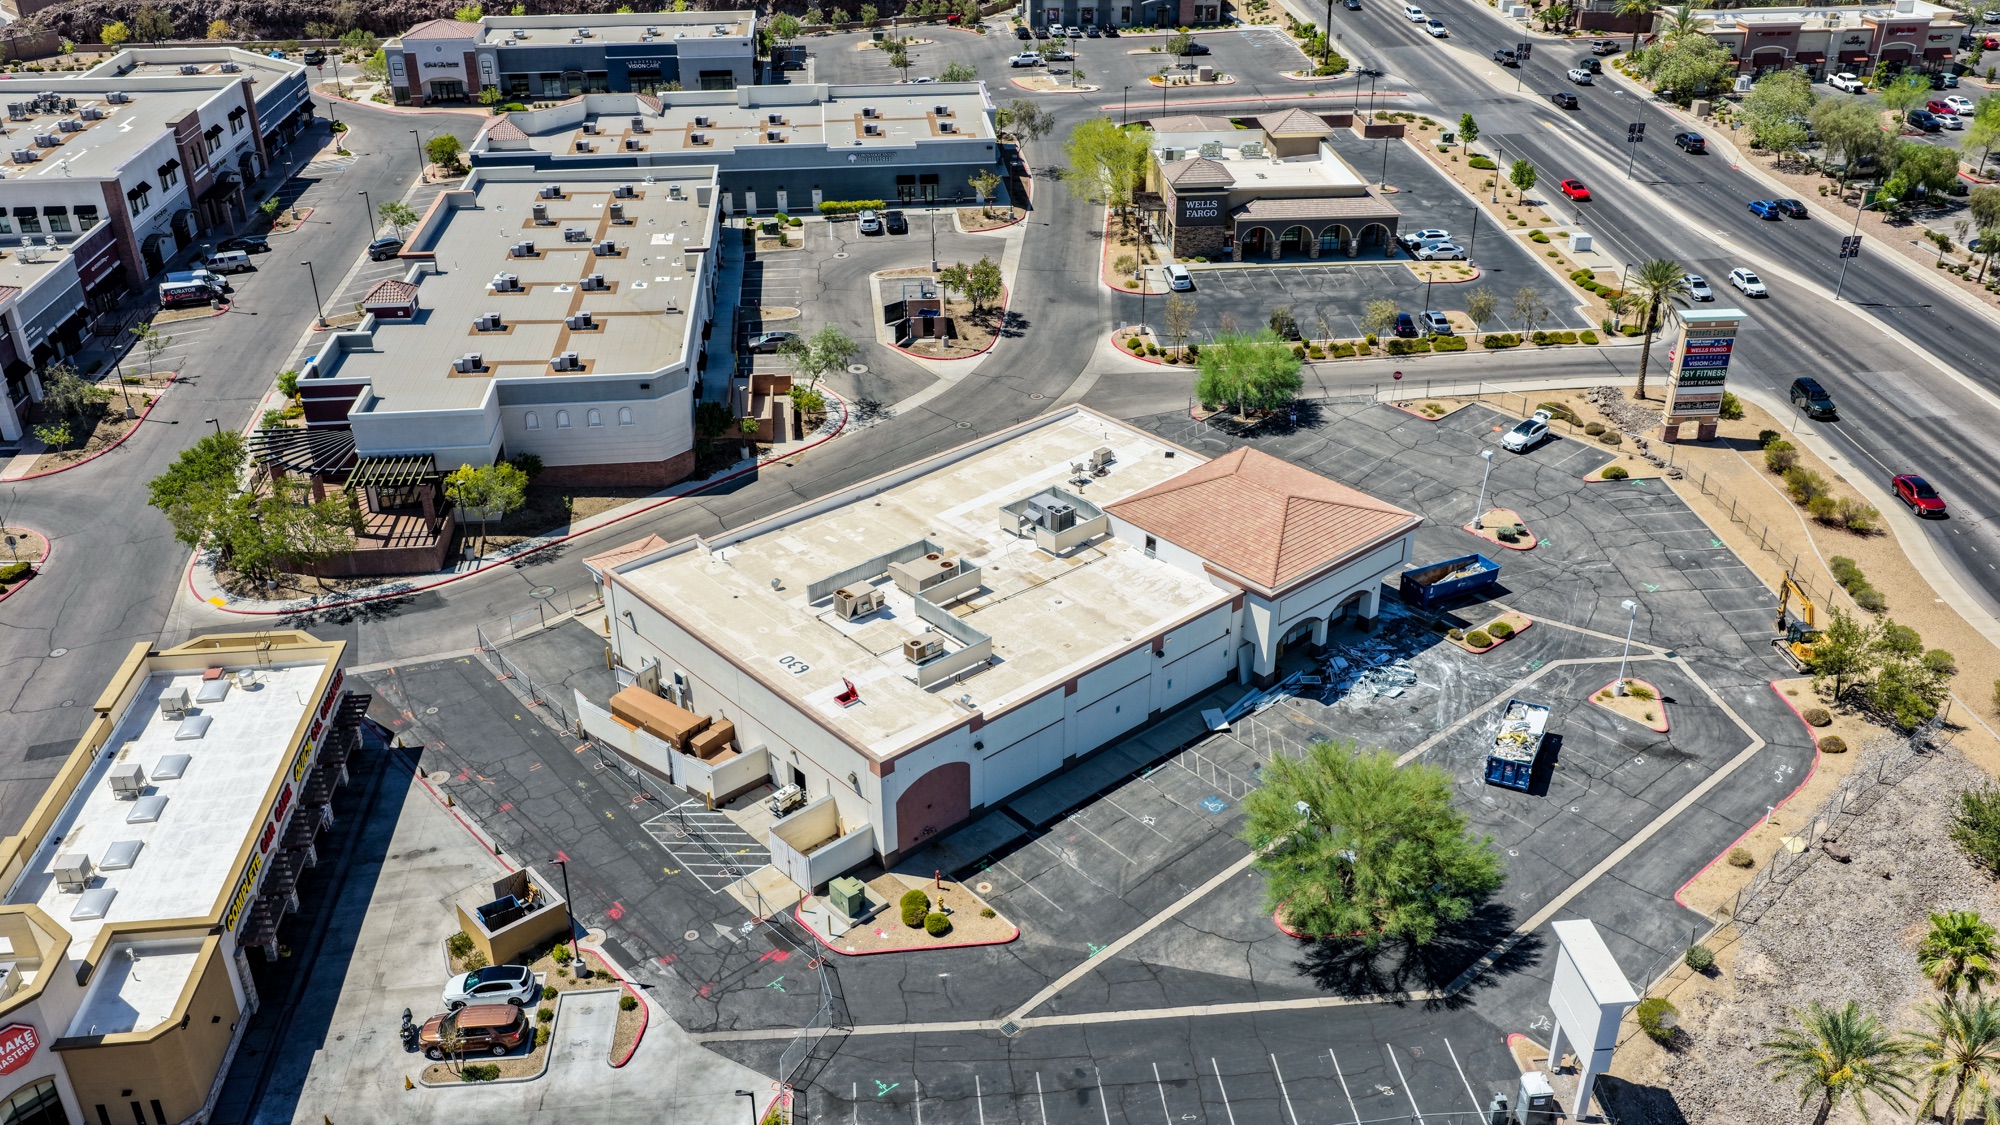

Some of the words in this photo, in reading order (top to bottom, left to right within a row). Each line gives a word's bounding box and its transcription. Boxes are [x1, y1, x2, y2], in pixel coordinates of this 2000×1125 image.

[1185, 200, 1218, 208] WELLS
[1185, 209, 1218, 218] FARGO
[1680, 370, 1695, 378] FSY
[1696, 369, 1726, 377] FITNESS
[225, 851, 262, 932] COMPLETE
[260, 821, 276, 854] CAR
[274, 783, 293, 823] CARE
[294, 735, 313, 782] QUICK
[310, 718, 323, 742] OIL
[320, 668, 343, 720] CHANGE
[0, 1030, 33, 1055] RAKE
